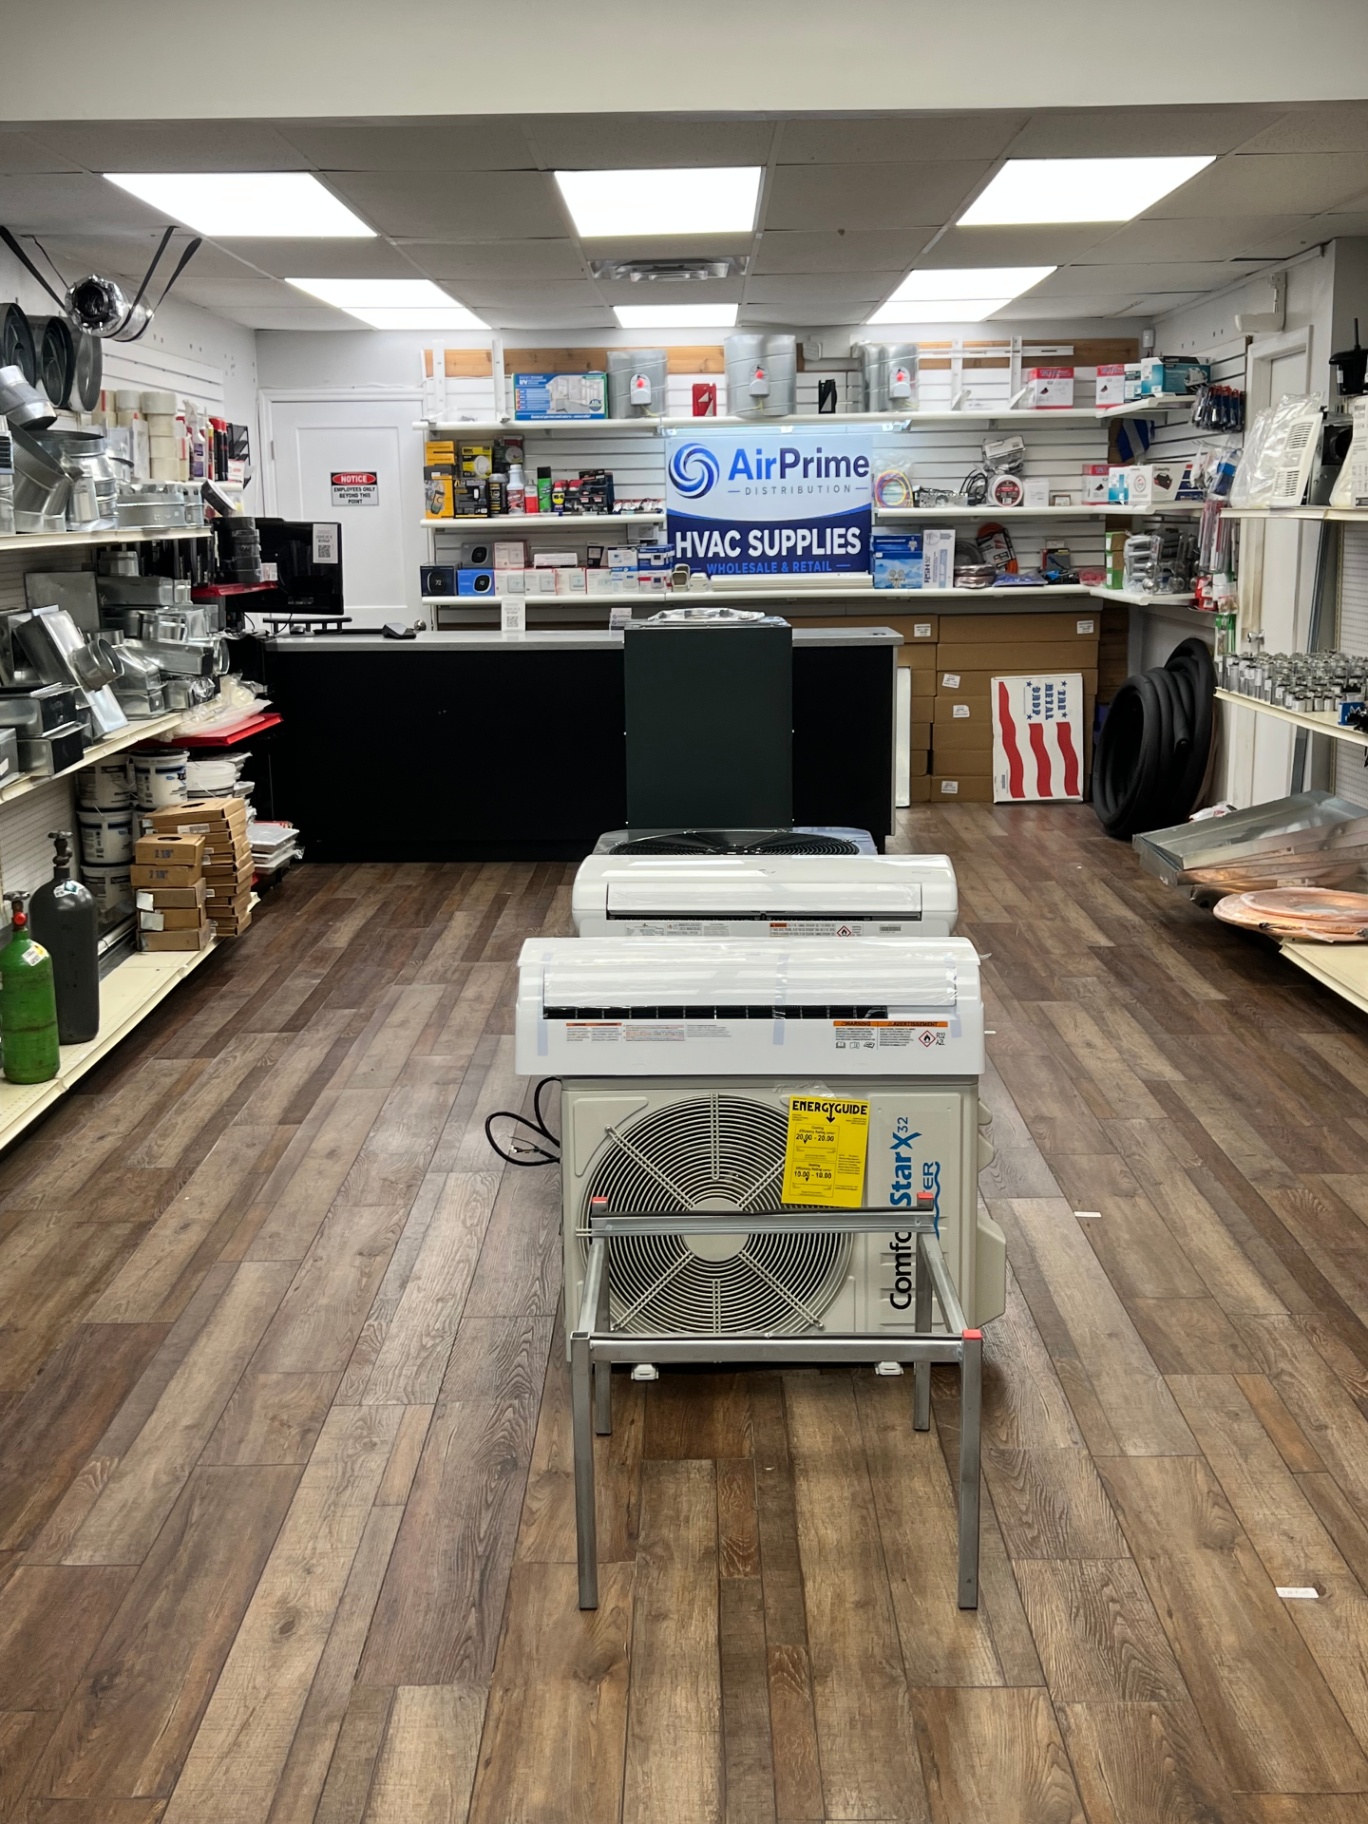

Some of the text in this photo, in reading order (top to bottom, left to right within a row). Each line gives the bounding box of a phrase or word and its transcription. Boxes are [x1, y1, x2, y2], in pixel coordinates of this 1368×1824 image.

[728, 447, 870, 481] AirPrime
[341, 475, 367, 483] NOTICE
[745, 485, 851, 495] DISTRIBUTION
[675, 527, 862, 558] HVAC SUPPLIES
[706, 560, 832, 574] WHOLESALE & RETAIL
[1032, 686, 1041, 716] SHOP
[1045, 683, 1054, 720] METAL
[1057, 690, 1066, 710] THE
[792, 1100, 868, 1115] ENERGYGUIDE
